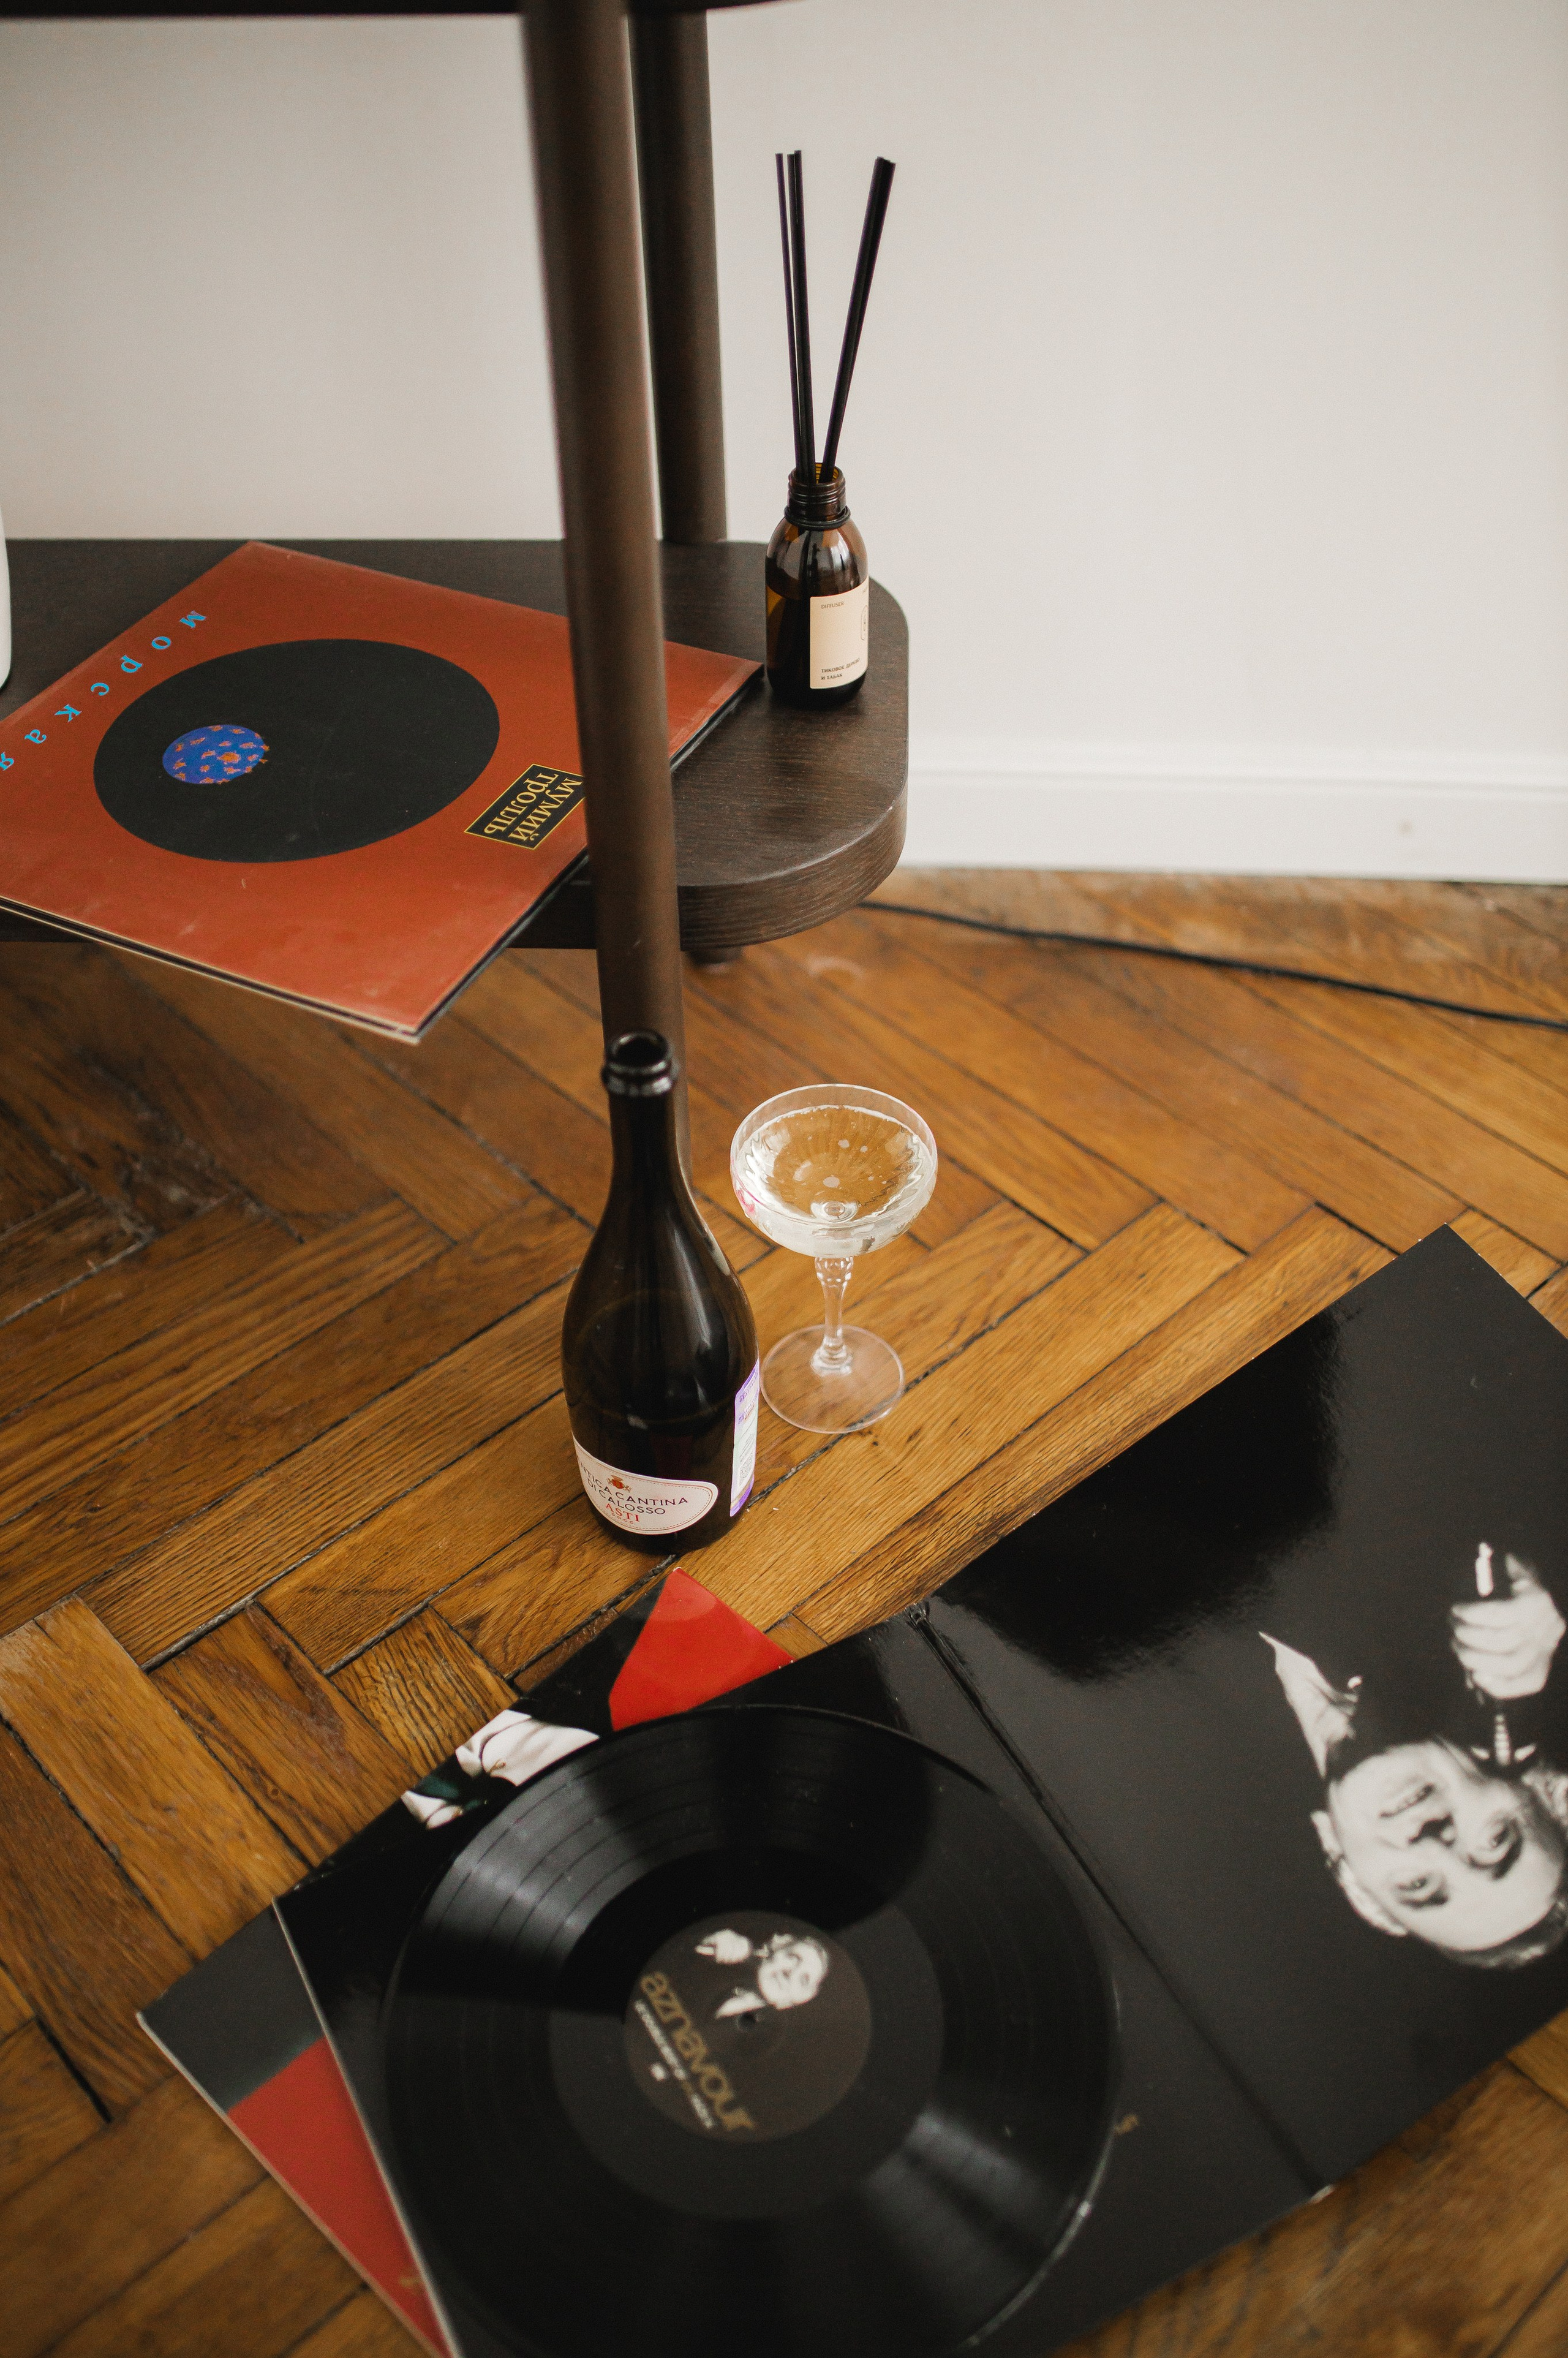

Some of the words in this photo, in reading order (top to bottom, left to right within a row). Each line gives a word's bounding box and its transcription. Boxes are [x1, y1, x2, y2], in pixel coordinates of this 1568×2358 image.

[484, 773, 559, 834] ТРОЛЛЬ
[508, 777, 583, 841] МУМИЙ
[587, 1478, 596, 1491] DI
[599, 1489, 665, 1515] CALOSSO
[606, 1503, 639, 1522] ASTI
[616, 1492, 688, 1506] CANTINA
[640, 1972, 755, 2130] aznavour
